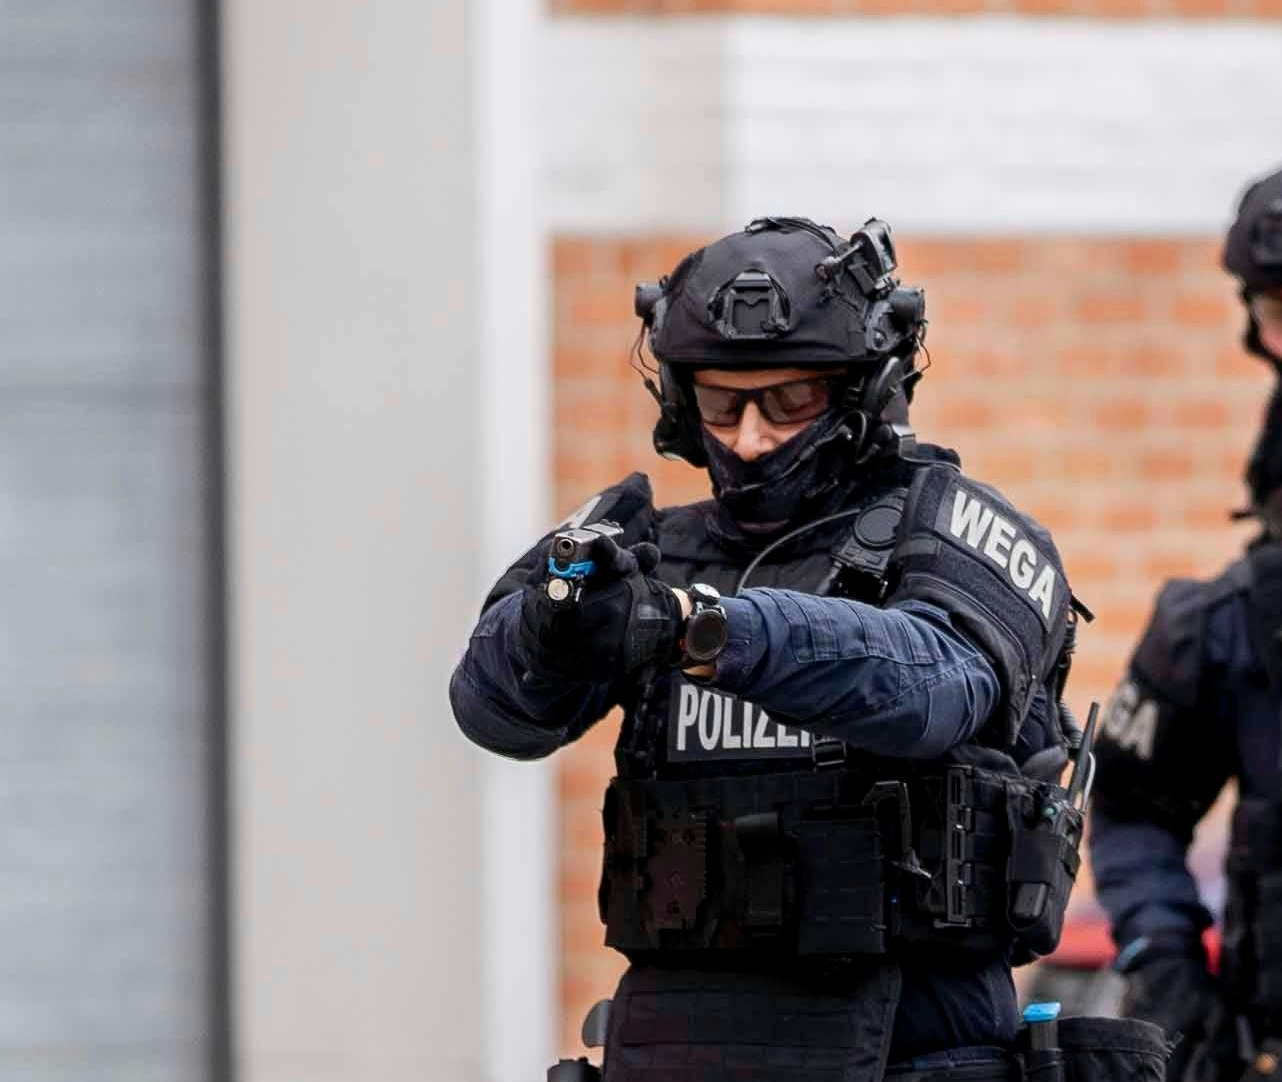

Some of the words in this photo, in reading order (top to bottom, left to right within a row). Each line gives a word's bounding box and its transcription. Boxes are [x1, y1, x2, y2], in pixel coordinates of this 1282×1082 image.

[950, 489, 1057, 621] WEGA
[676, 684, 811, 751] POLIZ
[1104, 682, 1159, 760] GA
